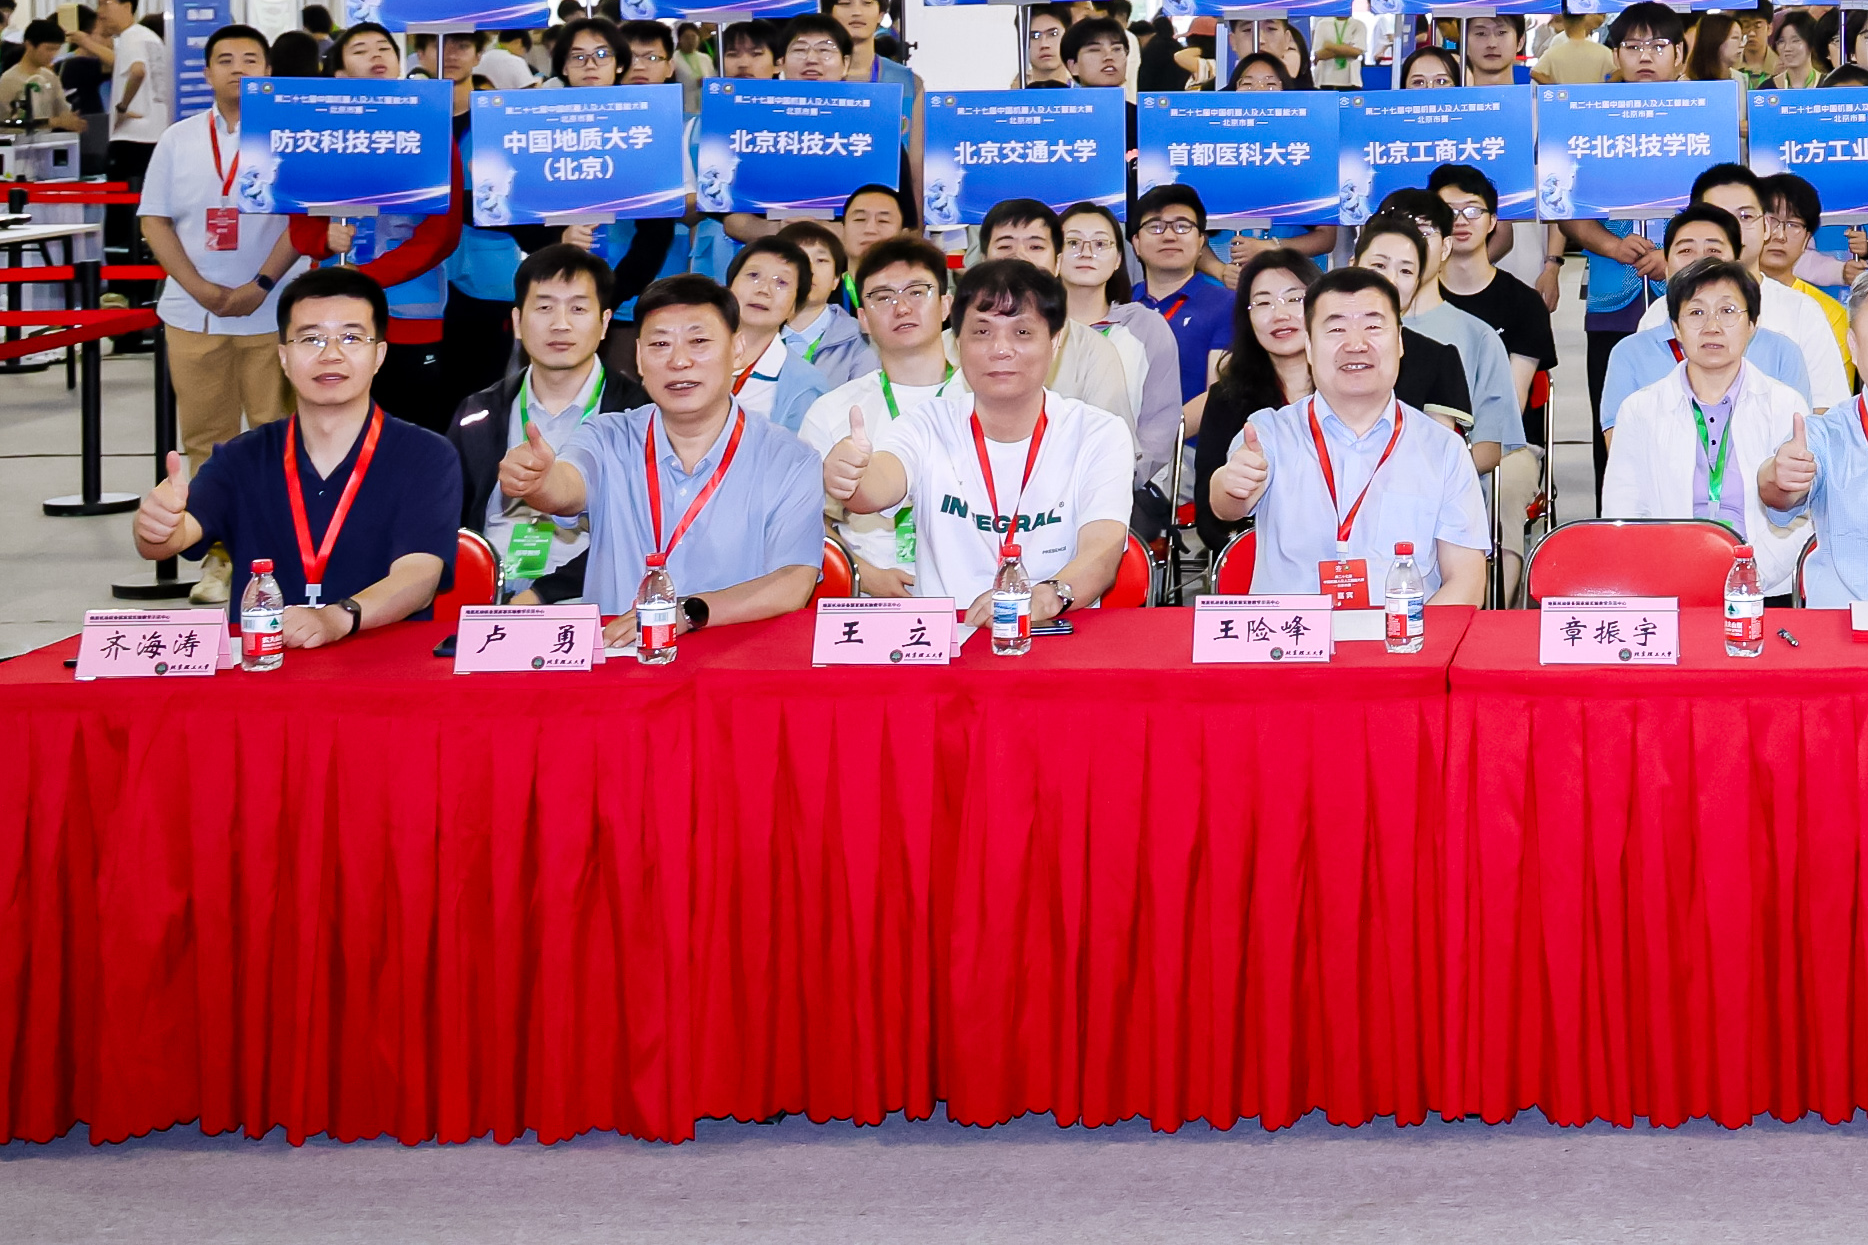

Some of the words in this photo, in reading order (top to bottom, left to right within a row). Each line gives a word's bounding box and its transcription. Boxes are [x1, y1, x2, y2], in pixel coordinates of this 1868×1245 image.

[269, 130, 420, 154] 防灾科技学院
[504, 126, 652, 153] 中国地质大学
[728, 130, 872, 158] 北京科技大学
[952, 140, 1096, 164] 北京交通大学
[1363, 137, 1505, 165] 北京工商大学
[1566, 133, 1710, 158] 华北科技学院
[1166, 142, 1310, 166] 首都医科大学
[940, 494, 1062, 533] INEGRAL
[100, 629, 201, 660] 齐海涛
[1213, 615, 1311, 646] 王险峰
[1560, 616, 1657, 646] 章振宇
